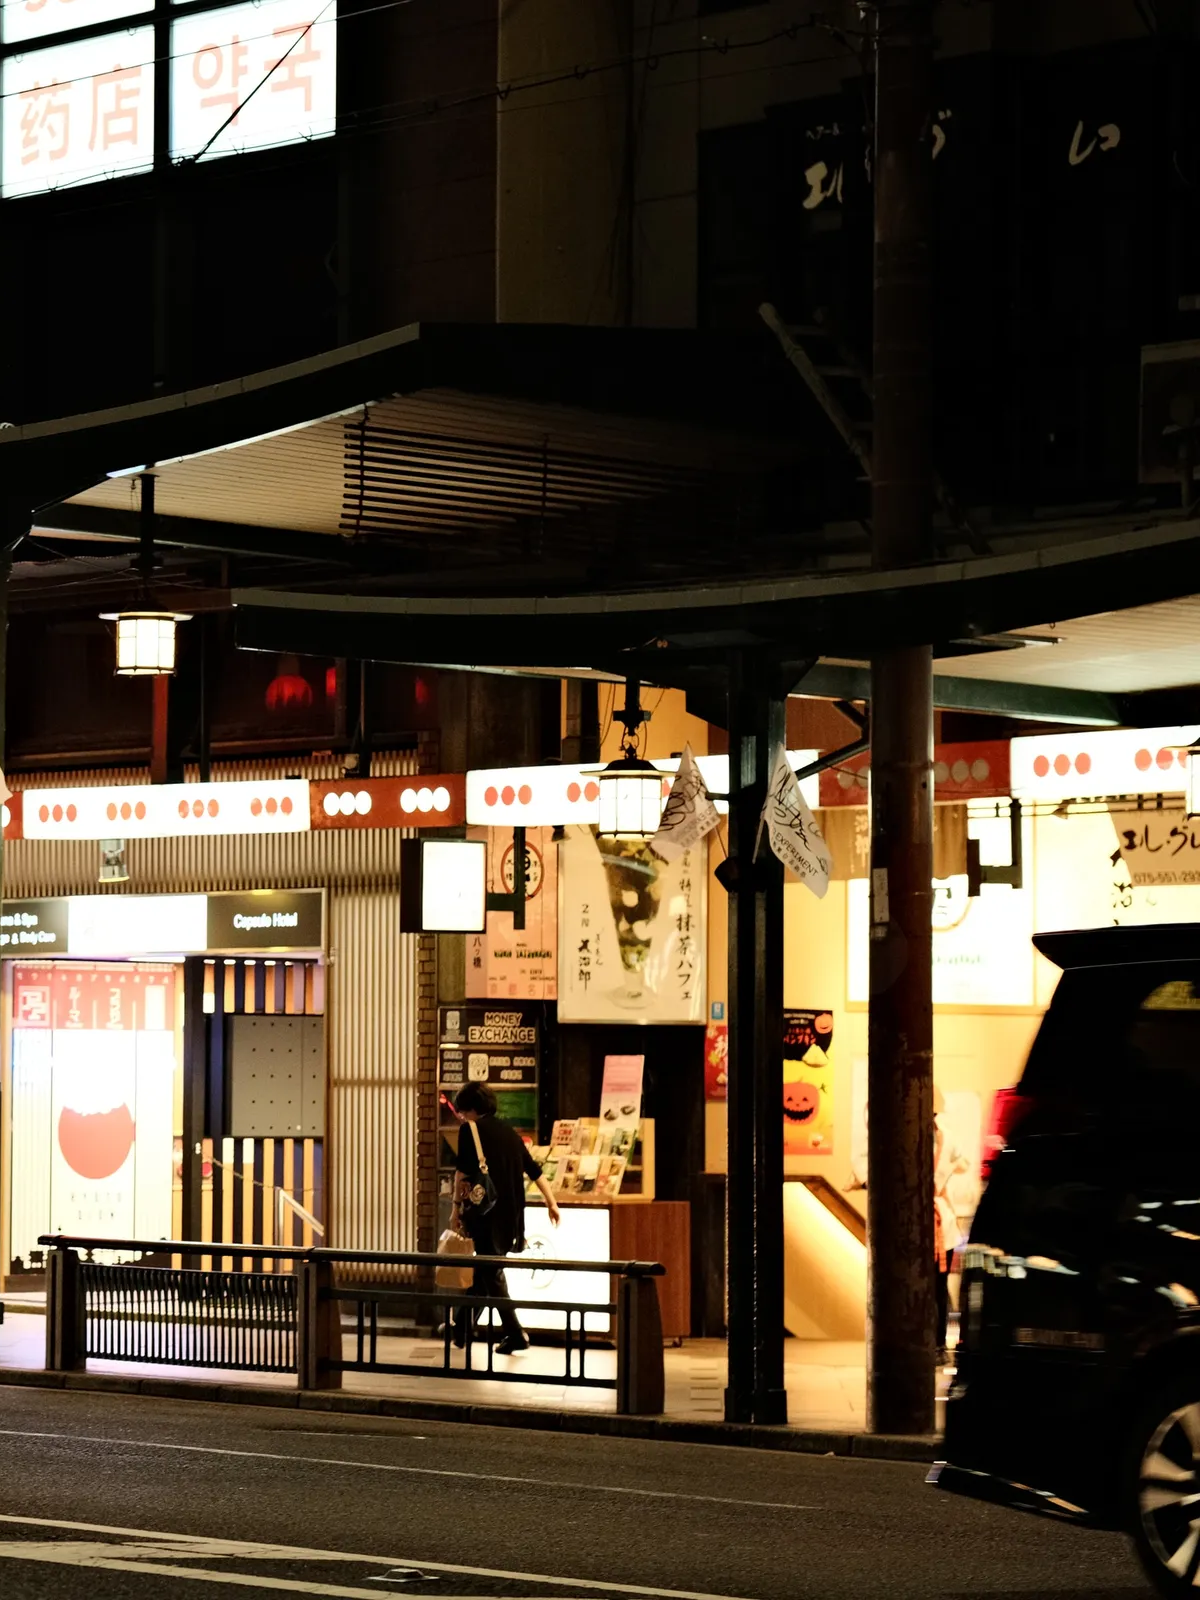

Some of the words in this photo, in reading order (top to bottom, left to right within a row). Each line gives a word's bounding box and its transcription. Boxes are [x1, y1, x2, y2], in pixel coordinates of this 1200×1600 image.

[192, 21, 321, 127] 약국
[18, 63, 143, 166] 药店
[775, 832, 819, 877] EXPERIMENT
[234, 914, 271, 931] Capsule
[273, 912, 298, 927] Hotel
[469, 1028, 536, 1042] EXCHANGE
[485, 1013, 522, 1025] MONEY
